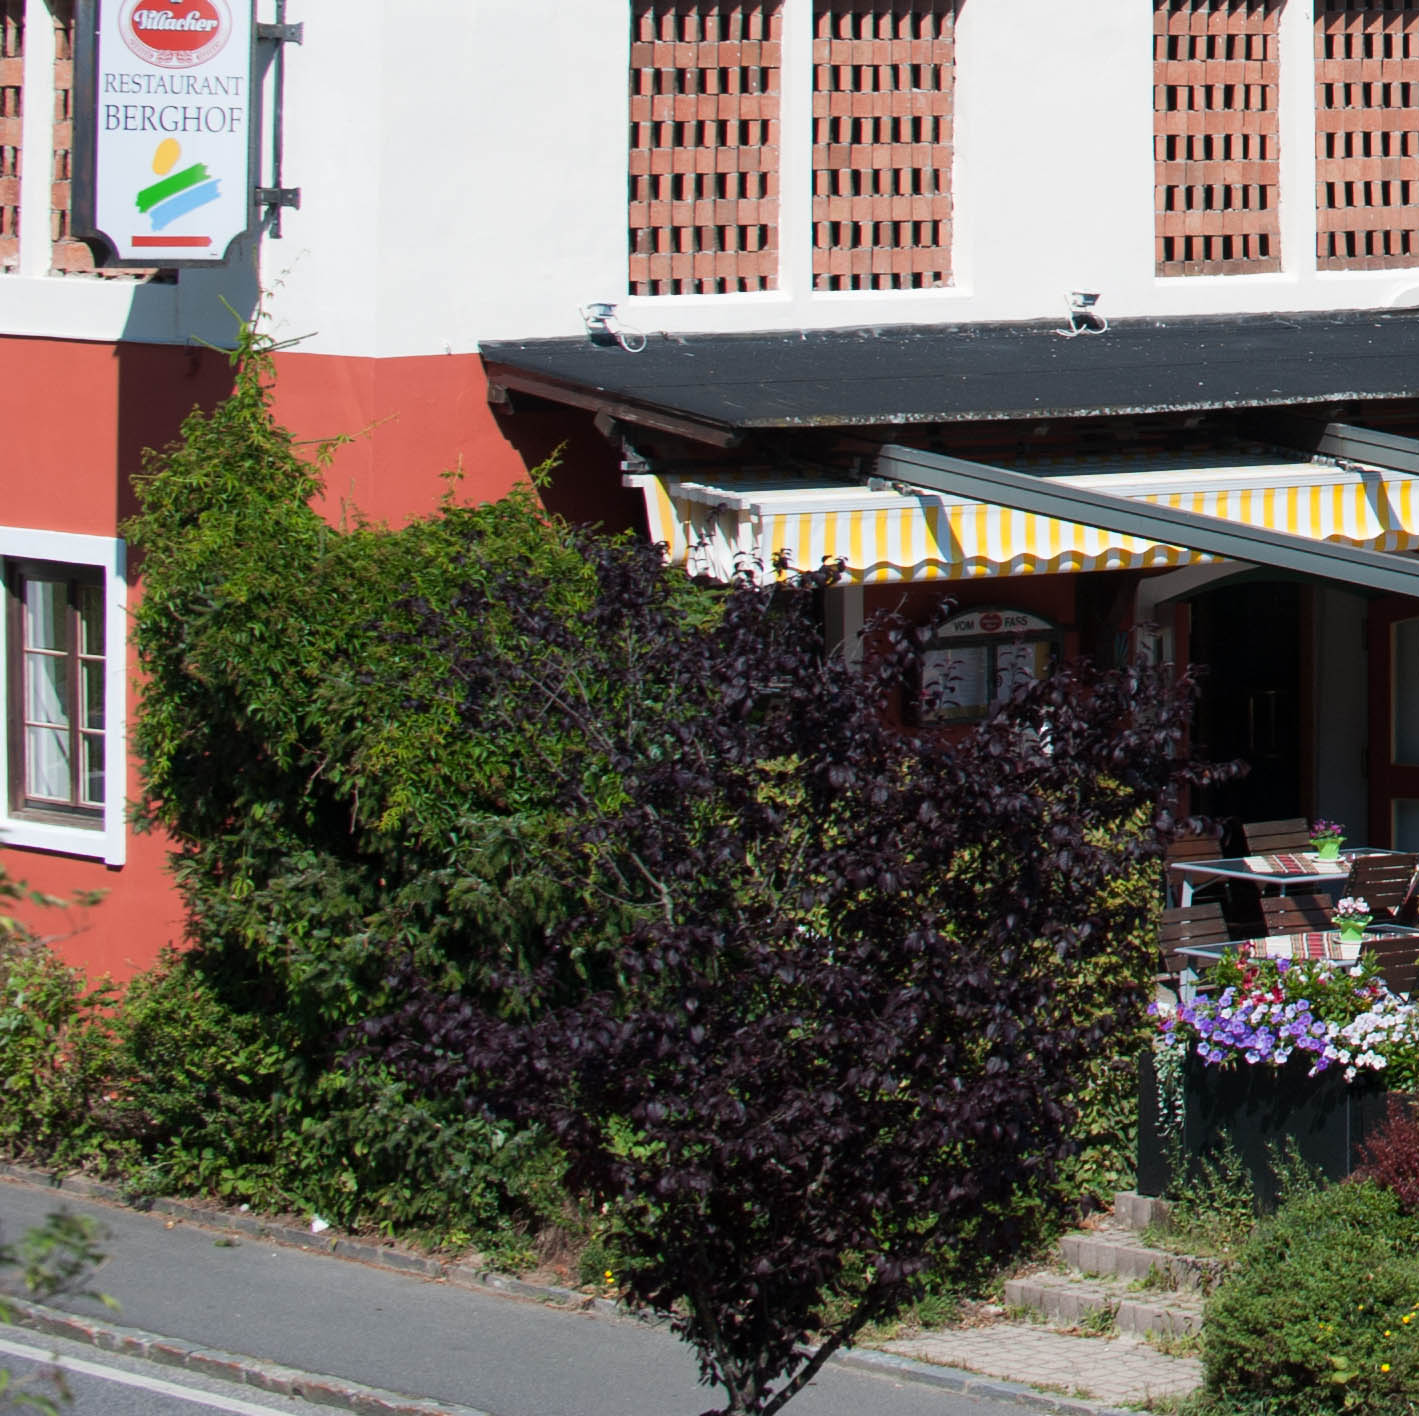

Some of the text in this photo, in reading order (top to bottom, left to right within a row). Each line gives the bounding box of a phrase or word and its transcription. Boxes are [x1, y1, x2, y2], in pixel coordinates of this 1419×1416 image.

[134, 9, 218, 32] Villacher
[105, 73, 243, 96] RESTAURANT
[105, 104, 243, 133] BERGHOF
[954, 619, 975, 631] VOM
[1004, 616, 1028, 627] FASS
